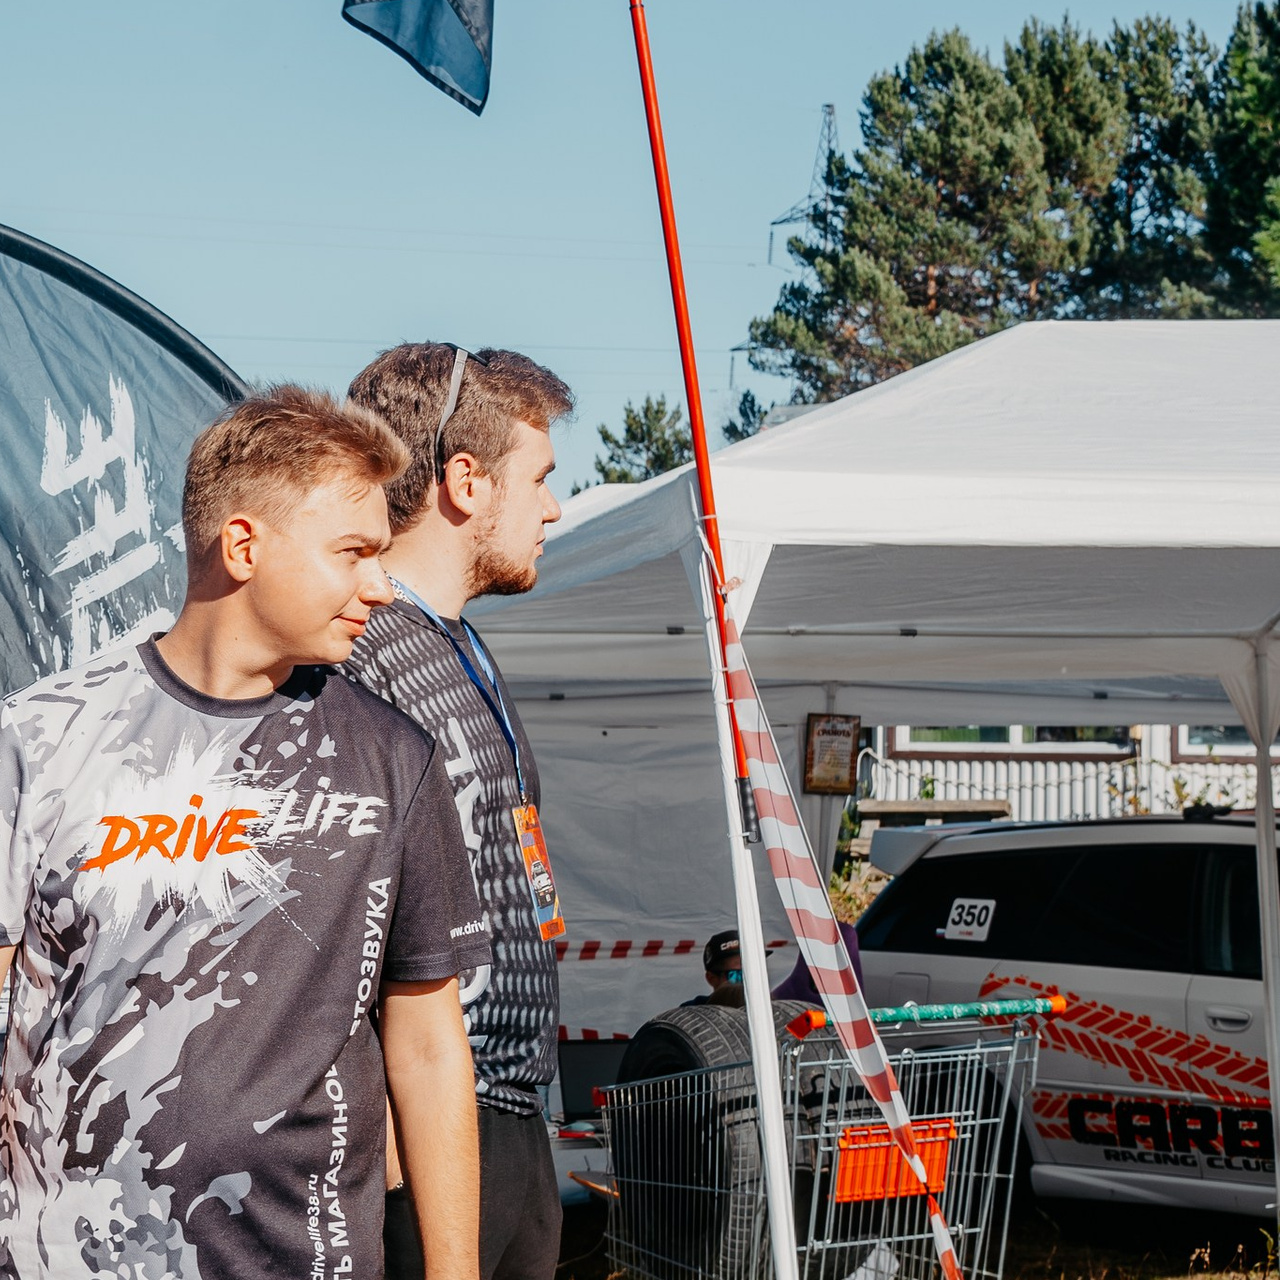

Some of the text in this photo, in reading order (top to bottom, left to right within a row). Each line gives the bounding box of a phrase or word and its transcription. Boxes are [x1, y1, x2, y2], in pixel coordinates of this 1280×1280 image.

[76, 776, 389, 874] DRIVE LIFE
[951, 904, 990, 927] 350
[350, 877, 392, 1036] ТОЗВУКА
[1104, 1149, 1198, 1167] RACING
